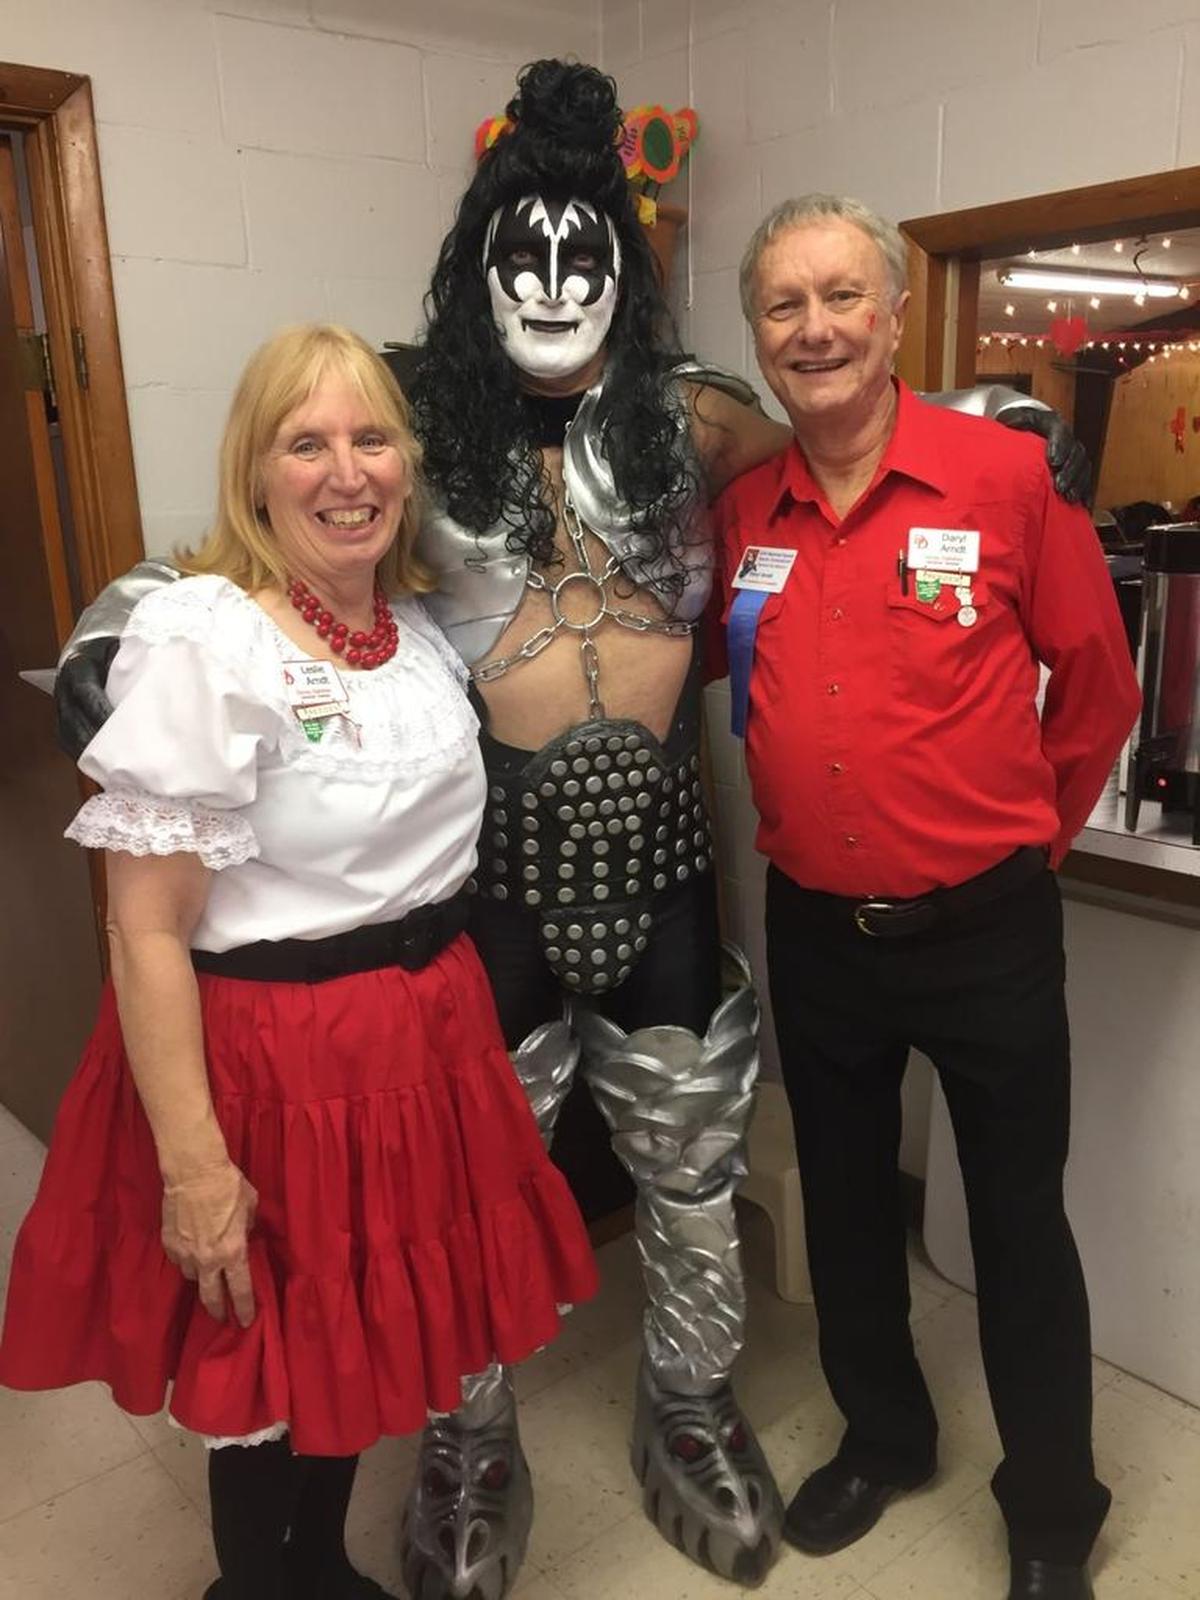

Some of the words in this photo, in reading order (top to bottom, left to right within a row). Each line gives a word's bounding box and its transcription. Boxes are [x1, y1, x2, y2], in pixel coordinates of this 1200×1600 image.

[941, 533, 967, 543] Daryl
[941, 544, 967, 554] Arndt
[300, 665, 326, 675] Leslie
